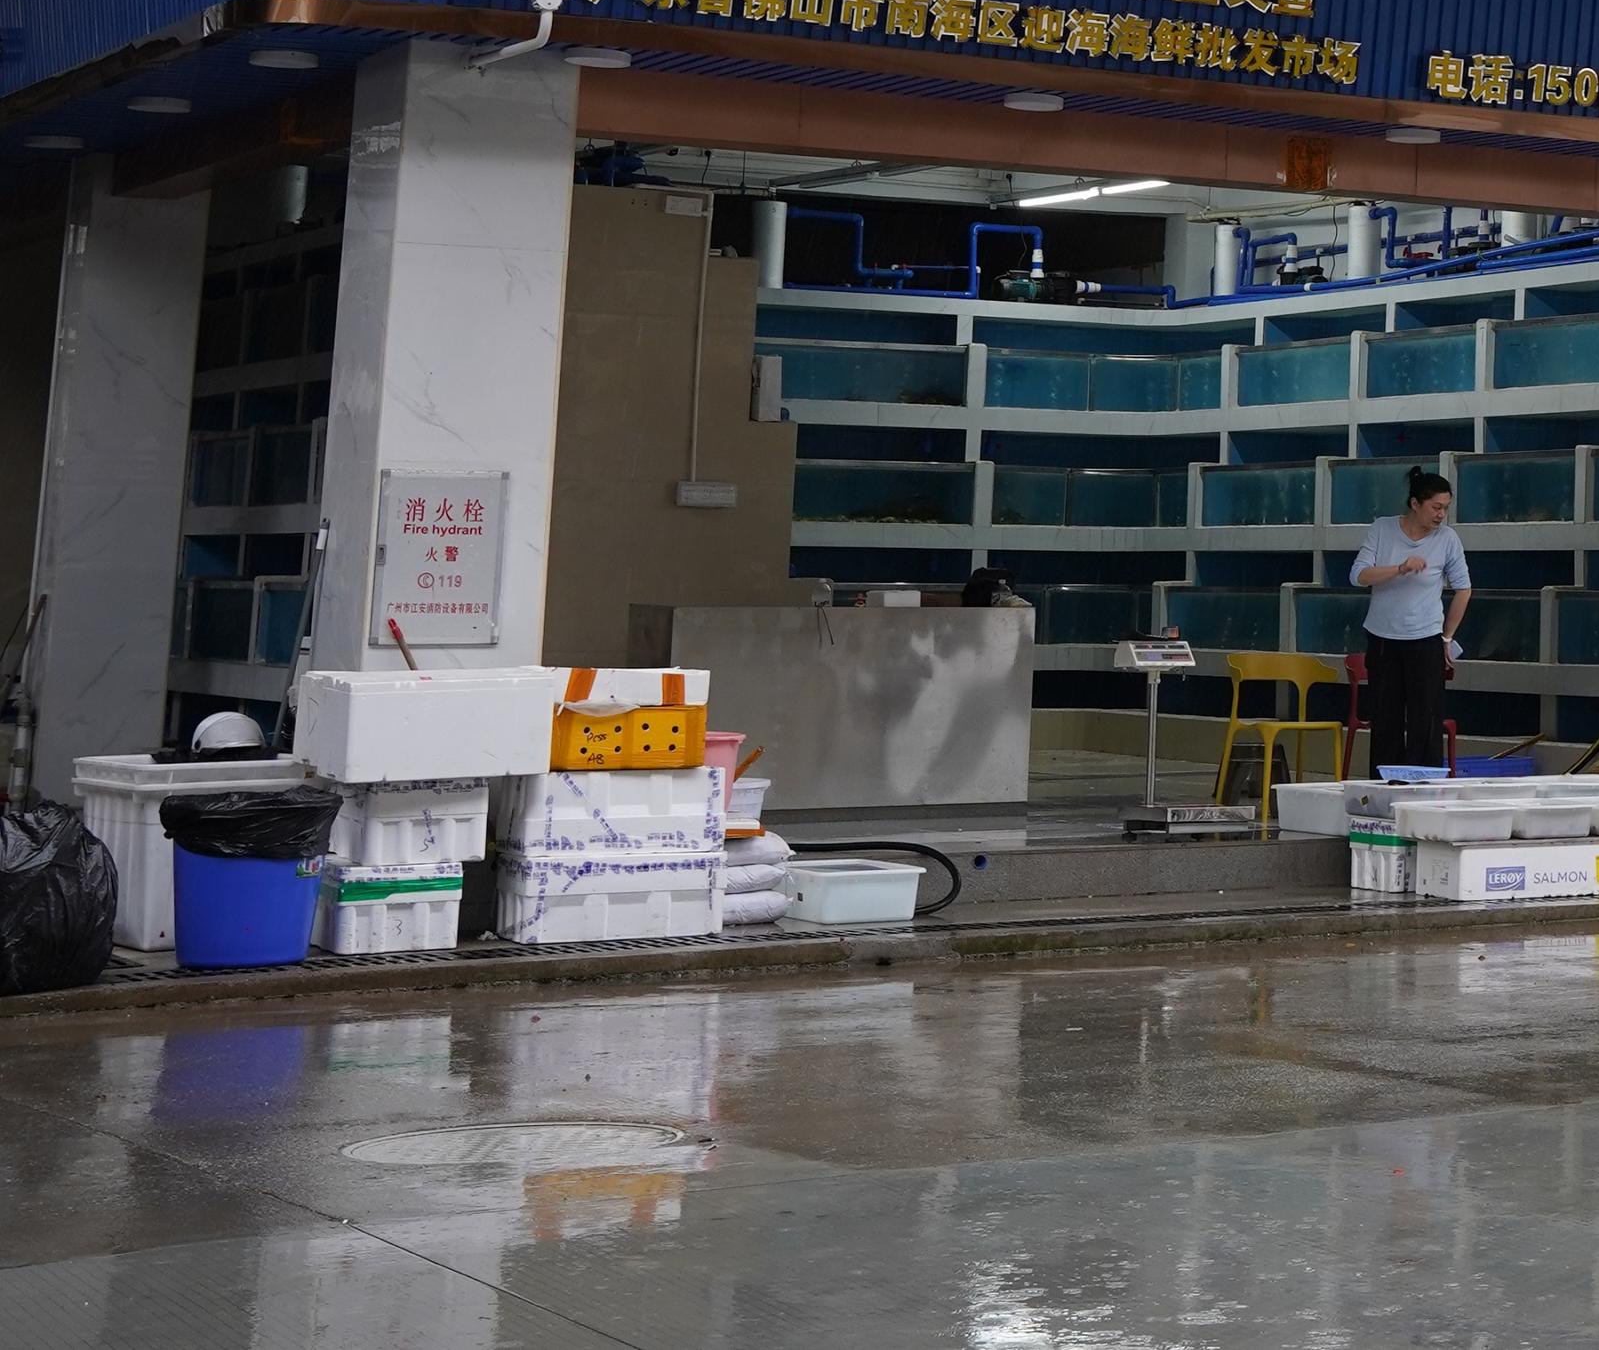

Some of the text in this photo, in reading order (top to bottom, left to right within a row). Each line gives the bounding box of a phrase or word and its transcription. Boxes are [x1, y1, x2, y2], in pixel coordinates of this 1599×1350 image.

[406, 497, 485, 523] 消火栓
[403, 523, 483, 538] Fire hydrant
[424, 545, 460, 563] 火警
[438, 574, 463, 588] 119
[1533, 870, 1588, 885] SALMON
